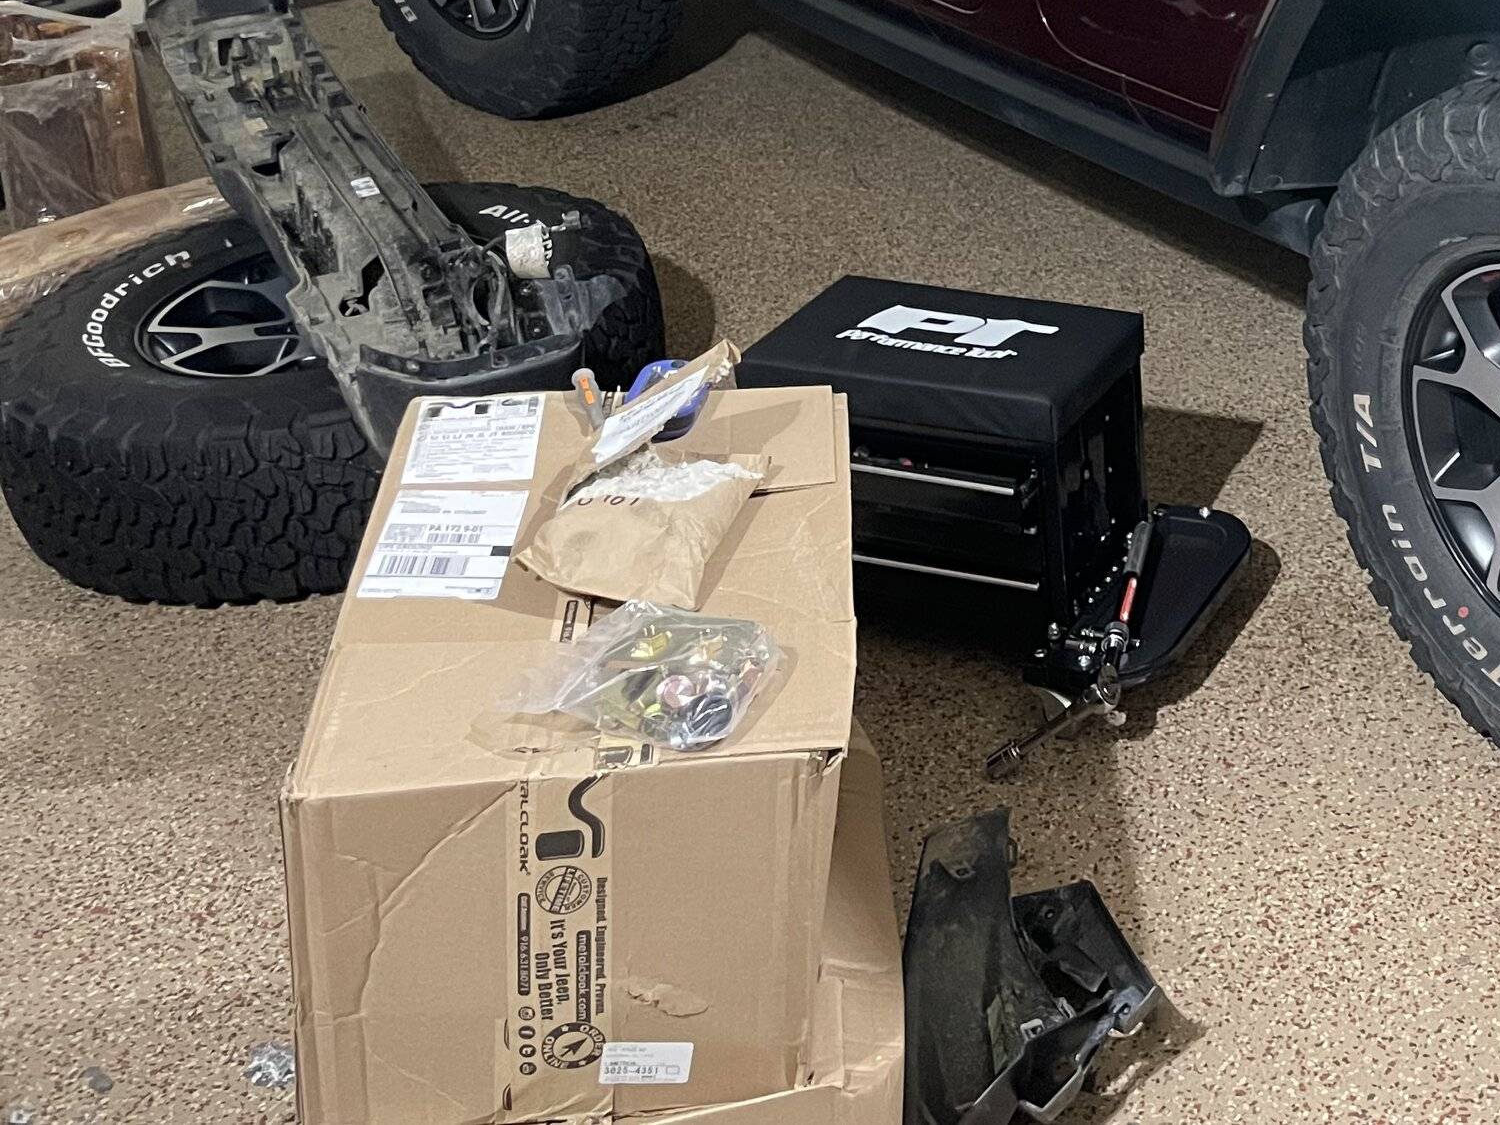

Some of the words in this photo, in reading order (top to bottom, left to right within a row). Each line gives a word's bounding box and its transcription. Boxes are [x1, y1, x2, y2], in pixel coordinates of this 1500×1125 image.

[81, 249, 191, 369] BFGoodrich
[835, 328, 967, 357] Performance
[1351, 392, 1385, 475] T/A
[552, 868, 576, 913] LIFETIME
[550, 919, 566, 940] It's
[534, 952, 551, 980] Only
[552, 941, 568, 970] Your
[578, 933, 590, 1021] metalcloak.com
[537, 982, 554, 1021] Better
[580, 1025, 602, 1057] ORDER
